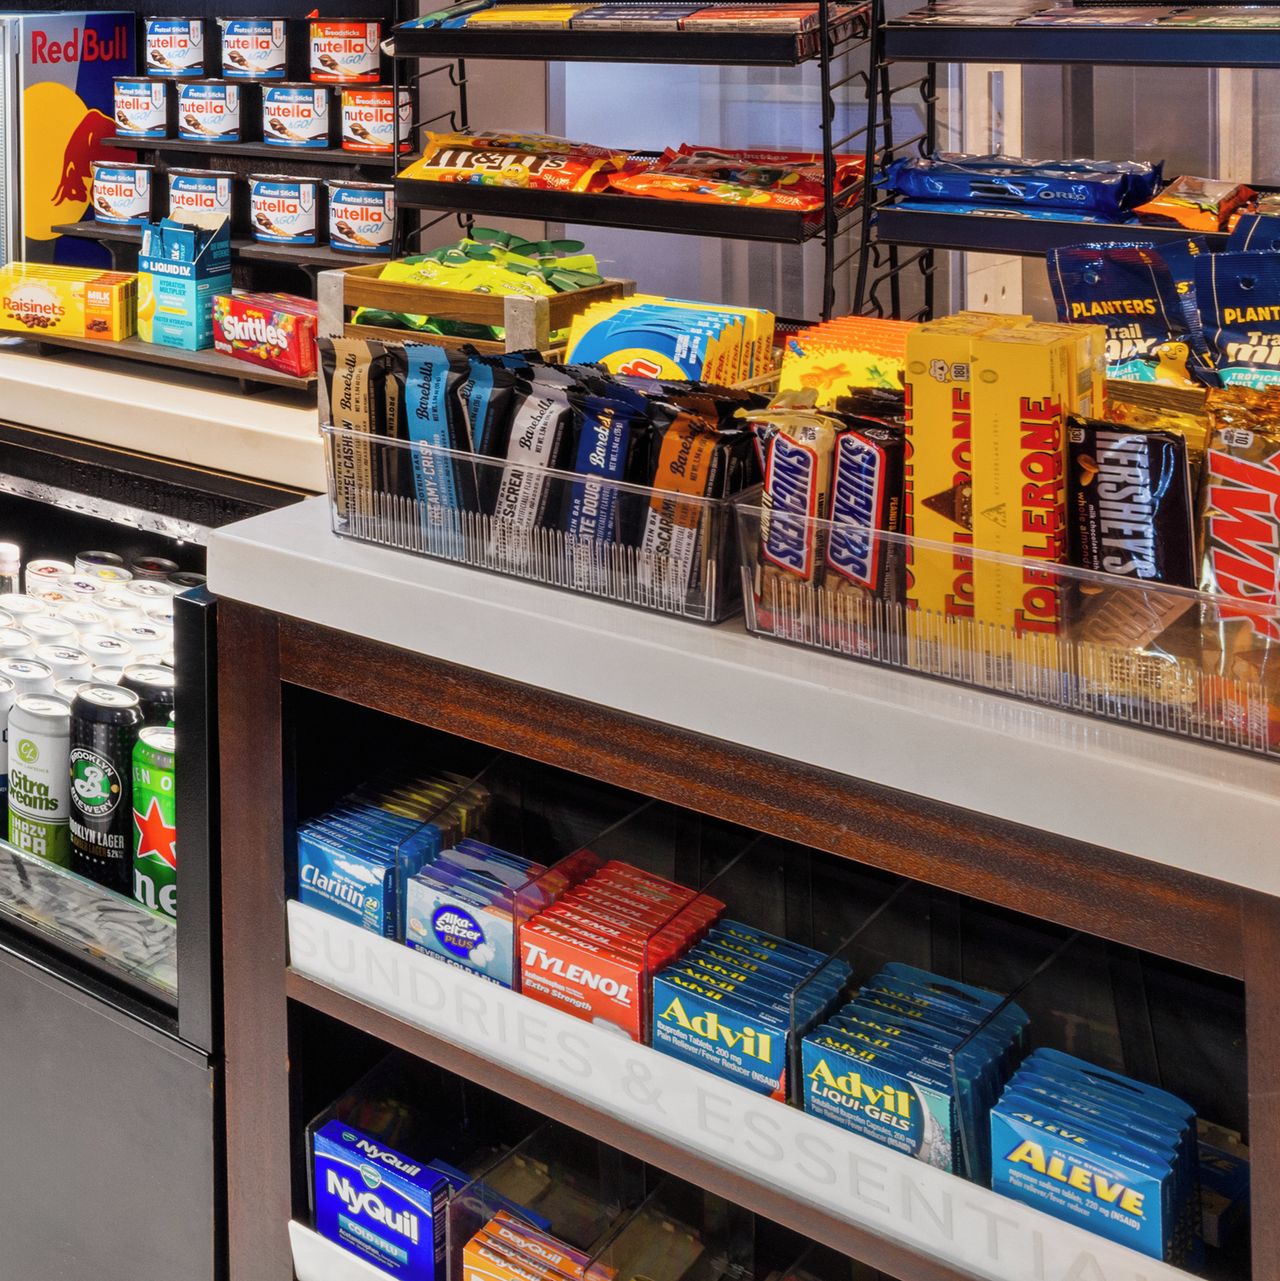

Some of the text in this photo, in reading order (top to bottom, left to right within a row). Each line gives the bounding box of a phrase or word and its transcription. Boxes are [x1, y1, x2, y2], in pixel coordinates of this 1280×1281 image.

[31, 25, 128, 65] Red Bull
[313, 39, 365, 55] nutella
[324, 28, 360, 37] Breadsticks
[355, 97, 391, 106] Breadsticks
[1039, 189, 1087, 201] OREO
[149, 261, 179, 275] LIQUID
[2, 296, 66, 316] Raisinets
[88, 290, 110, 302] MILK
[1072, 298, 1157, 319] PLANTERS
[168, 317, 193, 327] HYDRATION
[223, 314, 288, 349] Skittles
[340, 353, 357, 412] Barebells
[416, 361, 434, 422] Barebells
[519, 397, 555, 451] Barebells
[767, 440, 811, 569] SNICKERS
[829, 438, 877, 579] SNICKERS
[1014, 396, 1057, 639] TOBLERONE
[1079, 491, 1087, 520] whole
[1095, 431, 1157, 579] HERSHEY'S
[70, 750, 115, 778] BROOKLYN
[11, 768, 50, 797] Citra
[70, 786, 114, 815] BREWERY
[97, 830, 125, 850] LAGER
[301, 863, 364, 908] Claritin
[366, 897, 378, 908] 24
[435, 919, 481, 941] Seltzer
[440, 910, 473, 929] Alka-
[414, 943, 446, 962] SEVERE
[444, 934, 474, 950] PLUS
[532, 924, 600, 953] TYLENOL
[523, 942, 633, 1004] TYLENOL
[682, 967, 736, 992] Advil
[695, 959, 747, 982] Advil
[525, 980, 592, 1012] Extra Strength
[667, 974, 724, 1000] Advil
[290, 914, 670, 1115] SUNDRIES &
[657, 1021, 742, 1066] Ibuprofen Tablets, 200 mg
[659, 997, 771, 1064] Advil
[657, 1029, 780, 1090] Pain Reliever/Fever Reducer (NSAID)
[1010, 1111, 1089, 1145] ALEVE
[356, 1138, 420, 1177] NyQuil
[1006, 1139, 1146, 1217] ALEVE
[326, 1168, 419, 1244] NyQuil
[1008, 1176, 1023, 1189] Pain
[1067, 1200, 1090, 1217] reducer
[1008, 1168, 1141, 1231] naproxen sodium tablets, 220 mg (NSAID)
[347, 1220, 374, 1244] COLD
[498, 1226, 563, 1266] DayQuil
